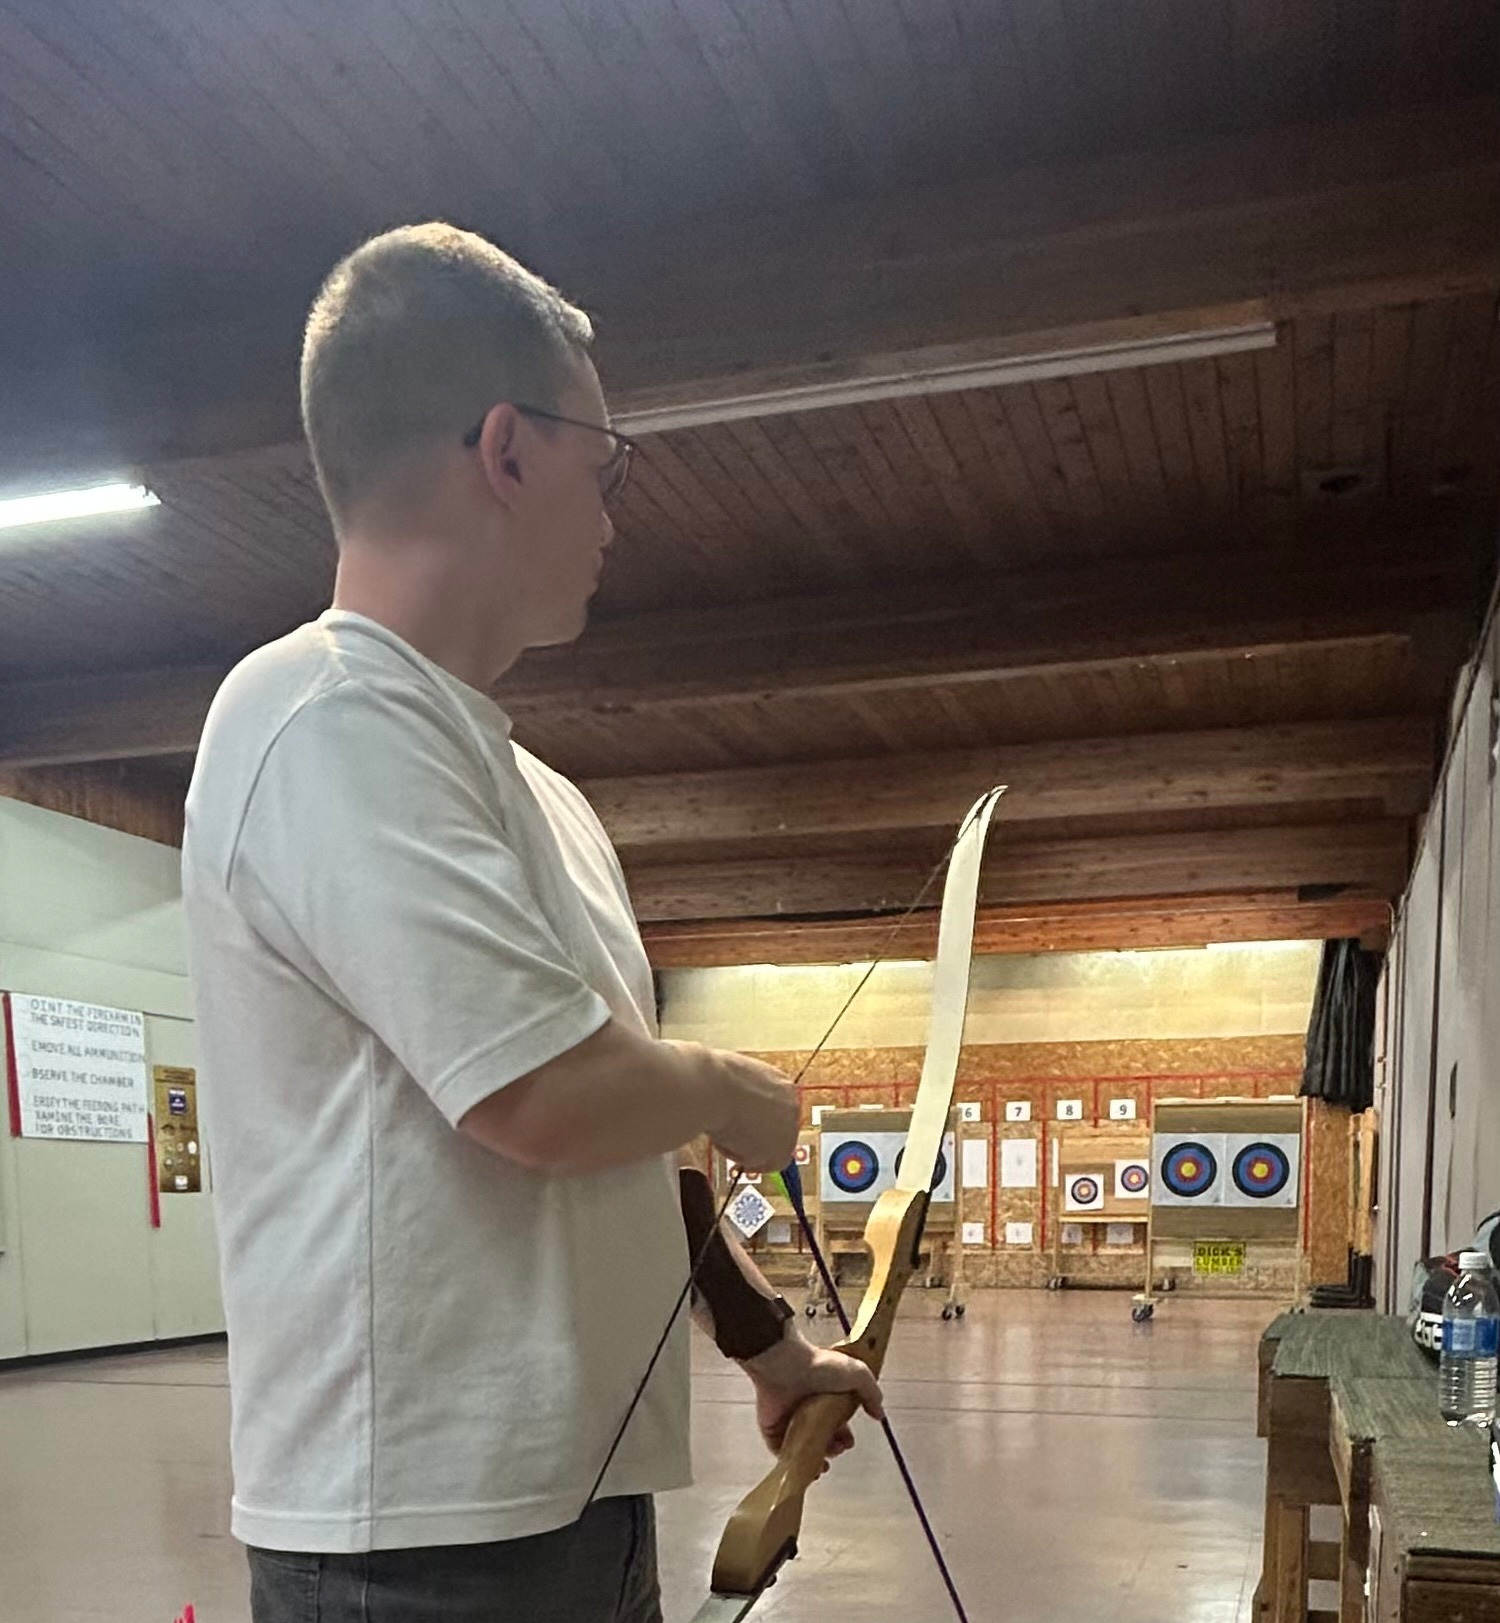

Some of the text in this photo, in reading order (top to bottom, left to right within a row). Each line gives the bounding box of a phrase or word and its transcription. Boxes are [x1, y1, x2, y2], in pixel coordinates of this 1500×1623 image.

[66, 1003, 84, 1018] THE
[130, 1014, 142, 1025] IN
[30, 1011, 140, 1037] THE SAFEST DIRECTION
[67, 1044, 82, 1057] ALL
[71, 1070, 88, 1085] THE
[90, 1073, 134, 1088] CHAMBER
[62, 1097, 80, 1110] THE
[121, 1102, 145, 1113] PATH
[1014, 1106, 1023, 1117] 7
[1065, 1105, 1074, 1116] 8
[1118, 1104, 1128, 1116] 9
[76, 1112, 92, 1125] THE
[964, 1107, 973, 1118] 6
[57, 1124, 133, 1139] OBSTRUCTIONS
[1198, 1246, 1243, 1257] DICK'S
[1196, 1256, 1244, 1266] LUMBER
